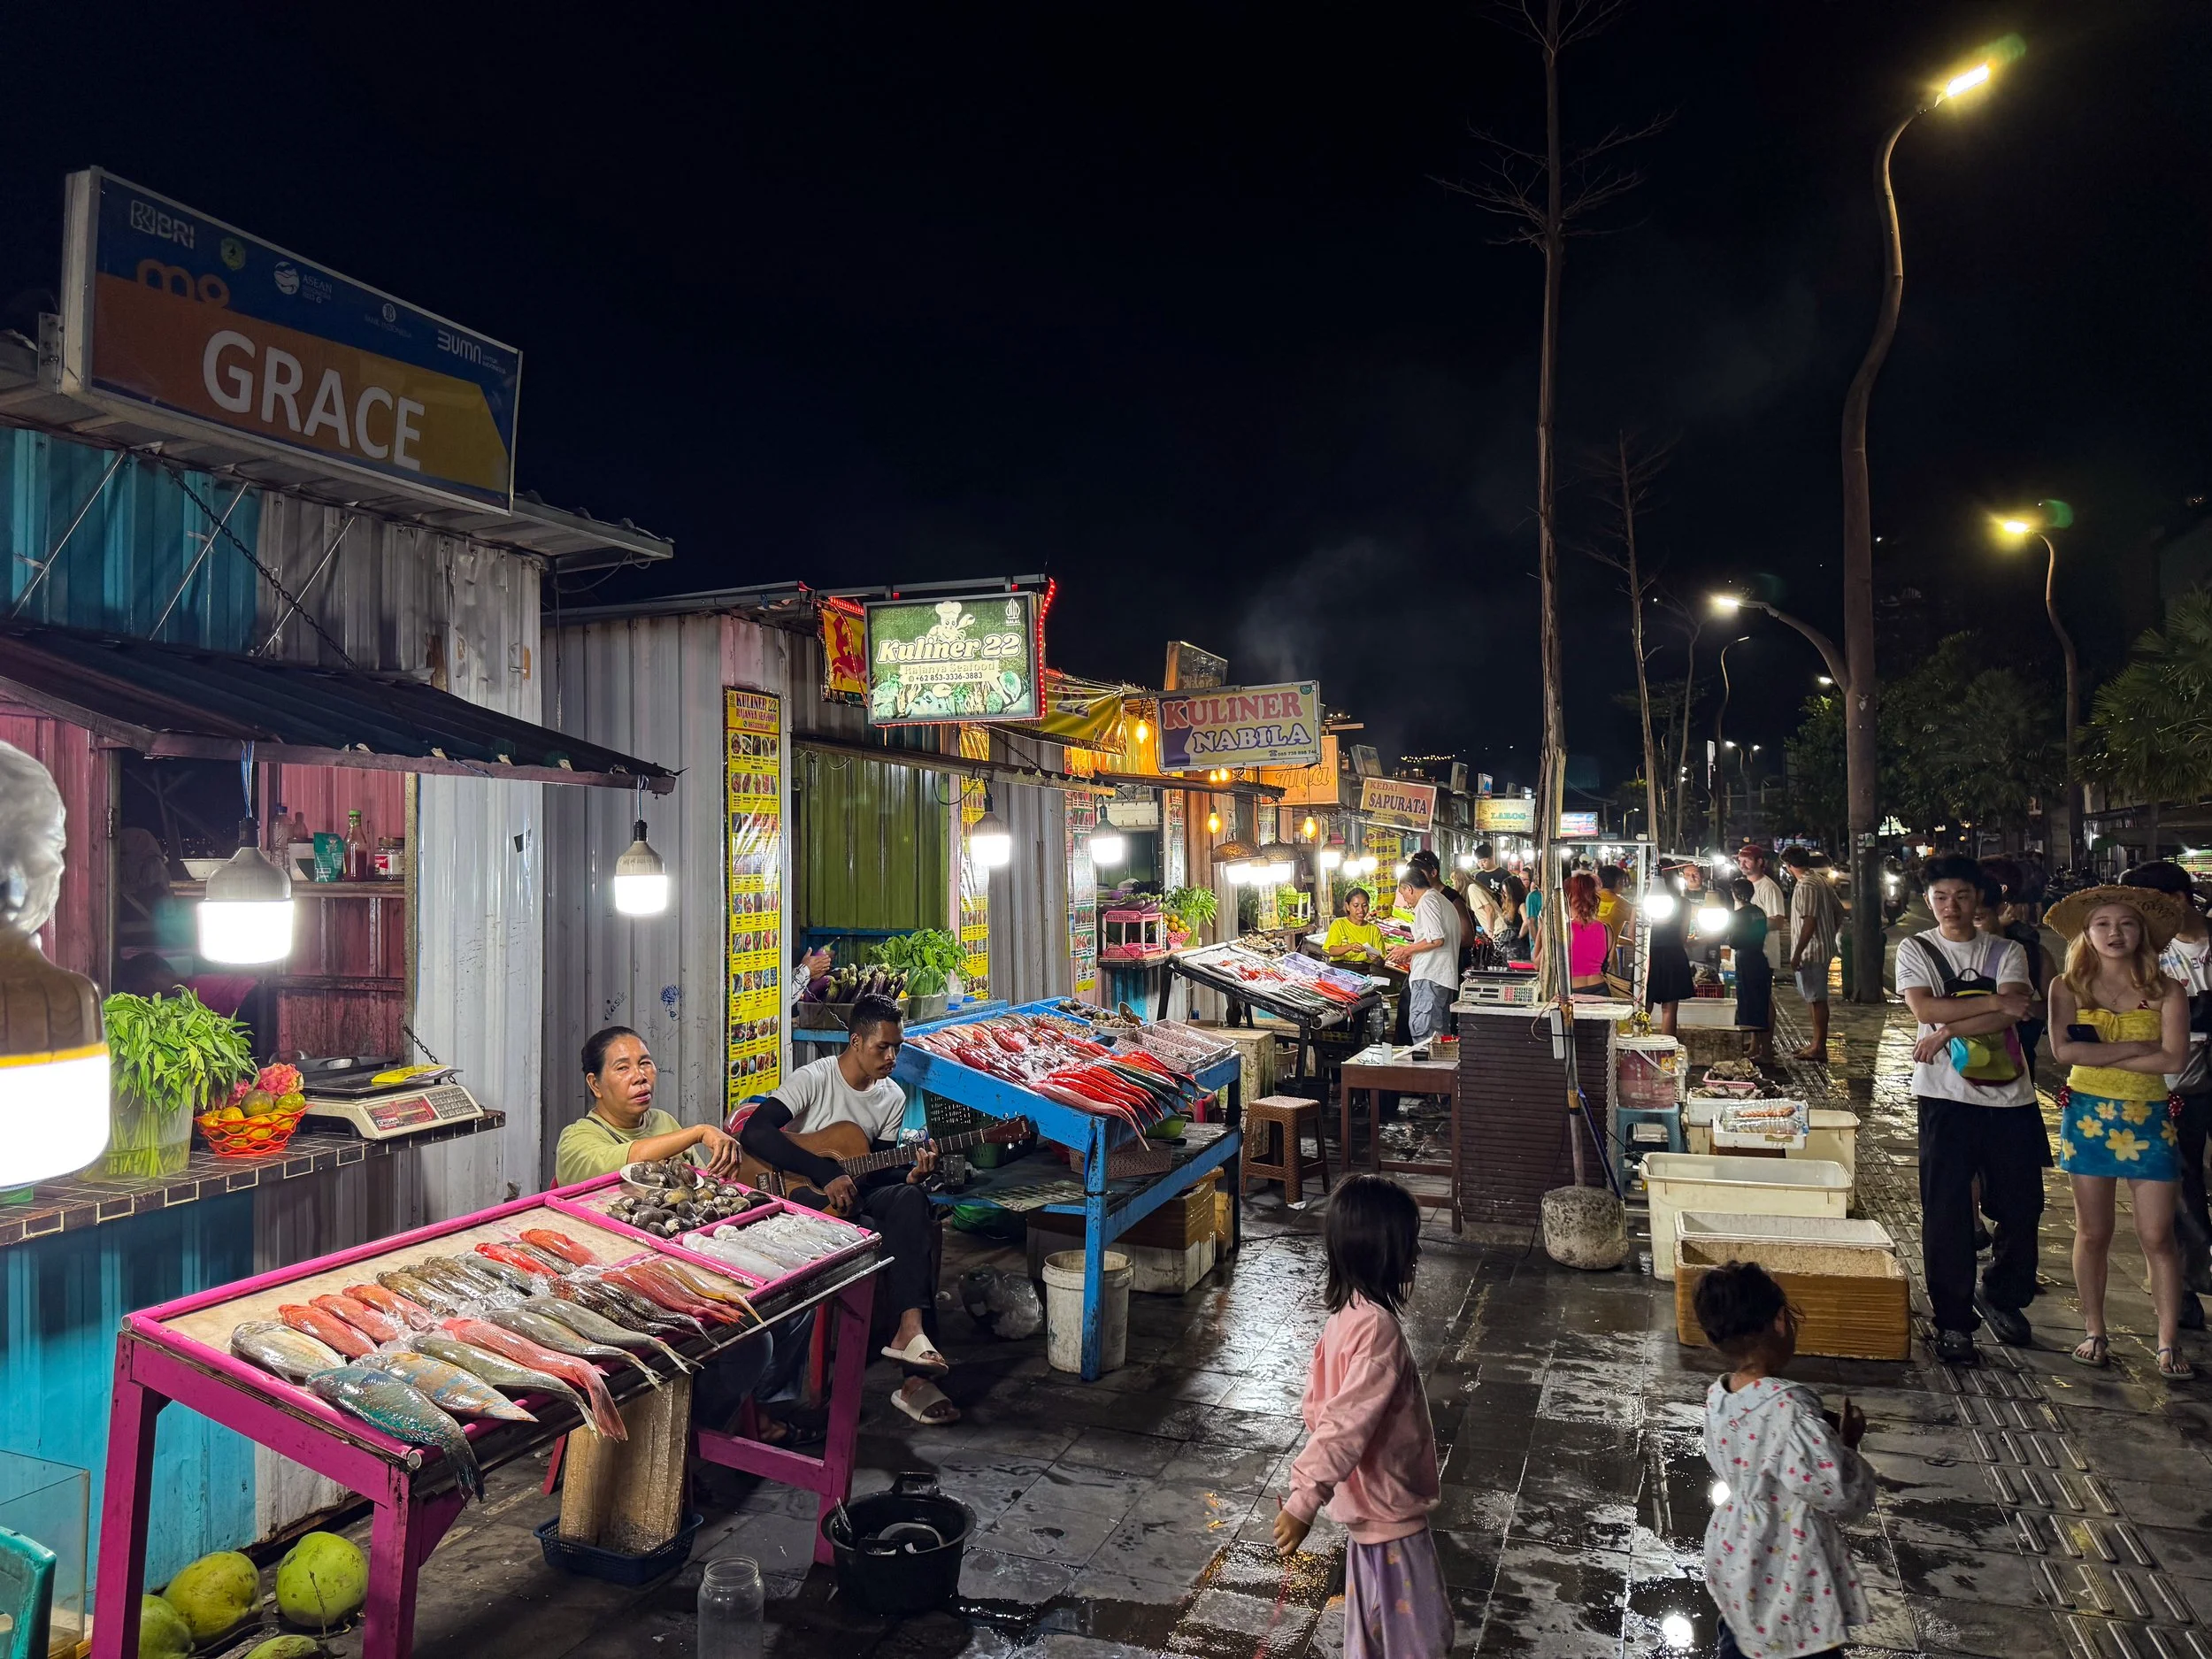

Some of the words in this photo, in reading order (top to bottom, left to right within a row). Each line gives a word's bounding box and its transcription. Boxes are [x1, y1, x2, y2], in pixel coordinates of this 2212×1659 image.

[157, 211, 195, 250] BRI
[303, 274, 333, 294] ASEAN
[202, 329, 426, 472] GRACE
[877, 637, 981, 663] Kuliner
[982, 634, 1021, 657] 22
[904, 664, 947, 675] Rajanya
[949, 662, 995, 672] Seafood
[736, 693, 768, 711] KULINER
[768, 699, 777, 713] 22
[1162, 691, 1303, 730] KULINER
[1193, 723, 1312, 753] NABILA
[1370, 781, 1398, 792] KEDAI
[1369, 792, 1427, 814] SAPURATA
